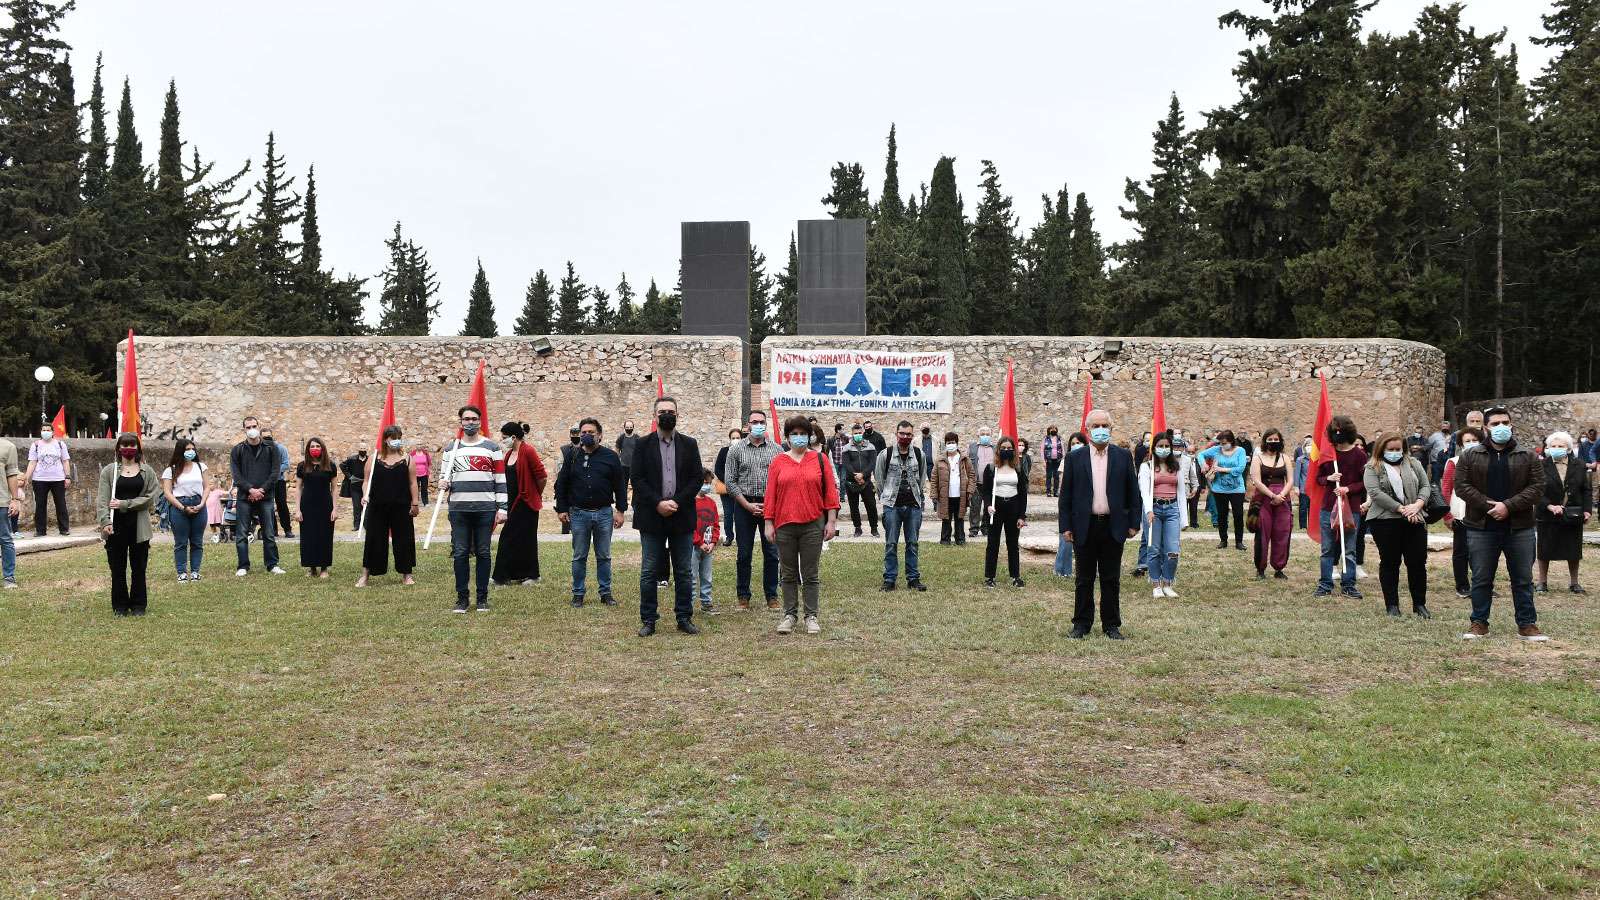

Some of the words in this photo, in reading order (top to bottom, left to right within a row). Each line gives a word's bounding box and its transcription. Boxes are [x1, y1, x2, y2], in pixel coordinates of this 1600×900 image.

[810, 353, 852, 365] ΣΥΜΜΑΧΙΑ
[777, 371, 807, 385] 1941
[915, 373, 948, 387] 1944
[831, 399, 851, 408] ΤΙΜΗ
